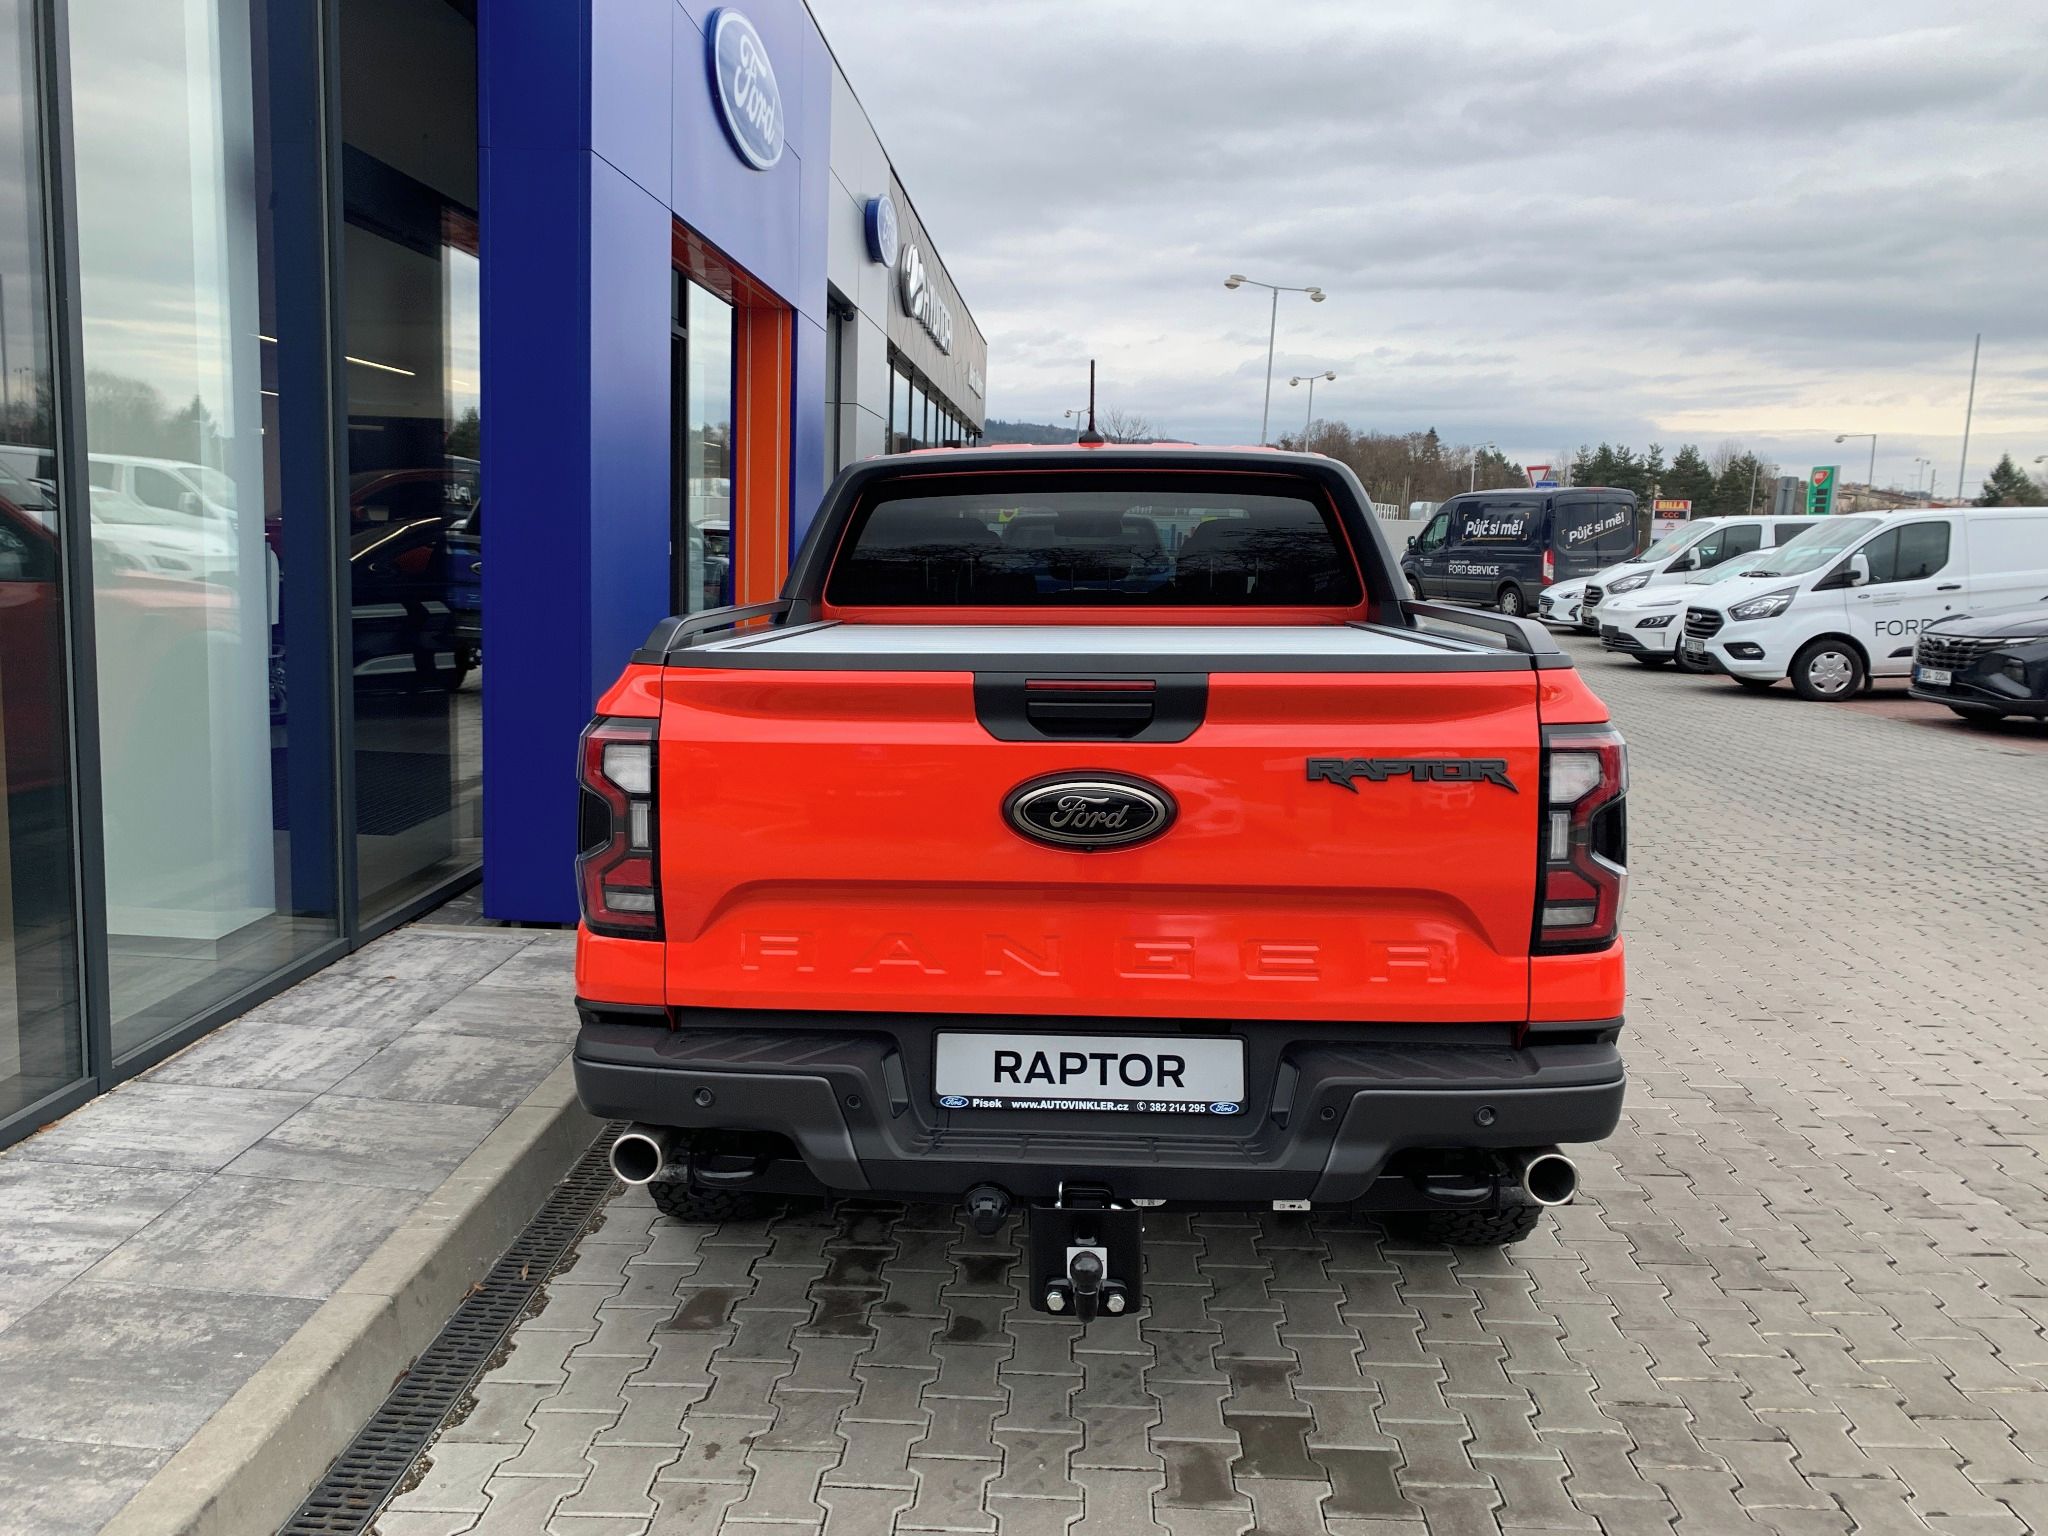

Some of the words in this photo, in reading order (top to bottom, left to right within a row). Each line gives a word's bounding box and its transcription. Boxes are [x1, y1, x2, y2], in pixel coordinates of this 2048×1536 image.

[733, 33, 775, 145] Ford
[1657, 501, 1685, 509] BILLA
[1662, 511, 1680, 519] CCC
[1465, 518, 1490, 538] Půjč
[1489, 520, 1501, 535] si
[1500, 519, 1524, 535] mě!
[1569, 522, 1594, 543] Půjč
[1594, 520, 1604, 533] si
[1605, 511, 1625, 529] mě!
[1448, 564, 1467, 575] FORD
[1467, 565, 1500, 576] SERVICE
[1306, 757, 1519, 794] RAPTOR
[1049, 795, 1130, 829] Ford
[740, 930, 1449, 985] RANGER
[993, 1049, 1186, 1088] RAPTOR
[1011, 1099, 1129, 1112] www.AUTOVINKLER.cz
[1149, 1103, 1167, 1112] 382
[1168, 1103, 1187, 1113] 214
[1188, 1103, 1206, 1113] 295
